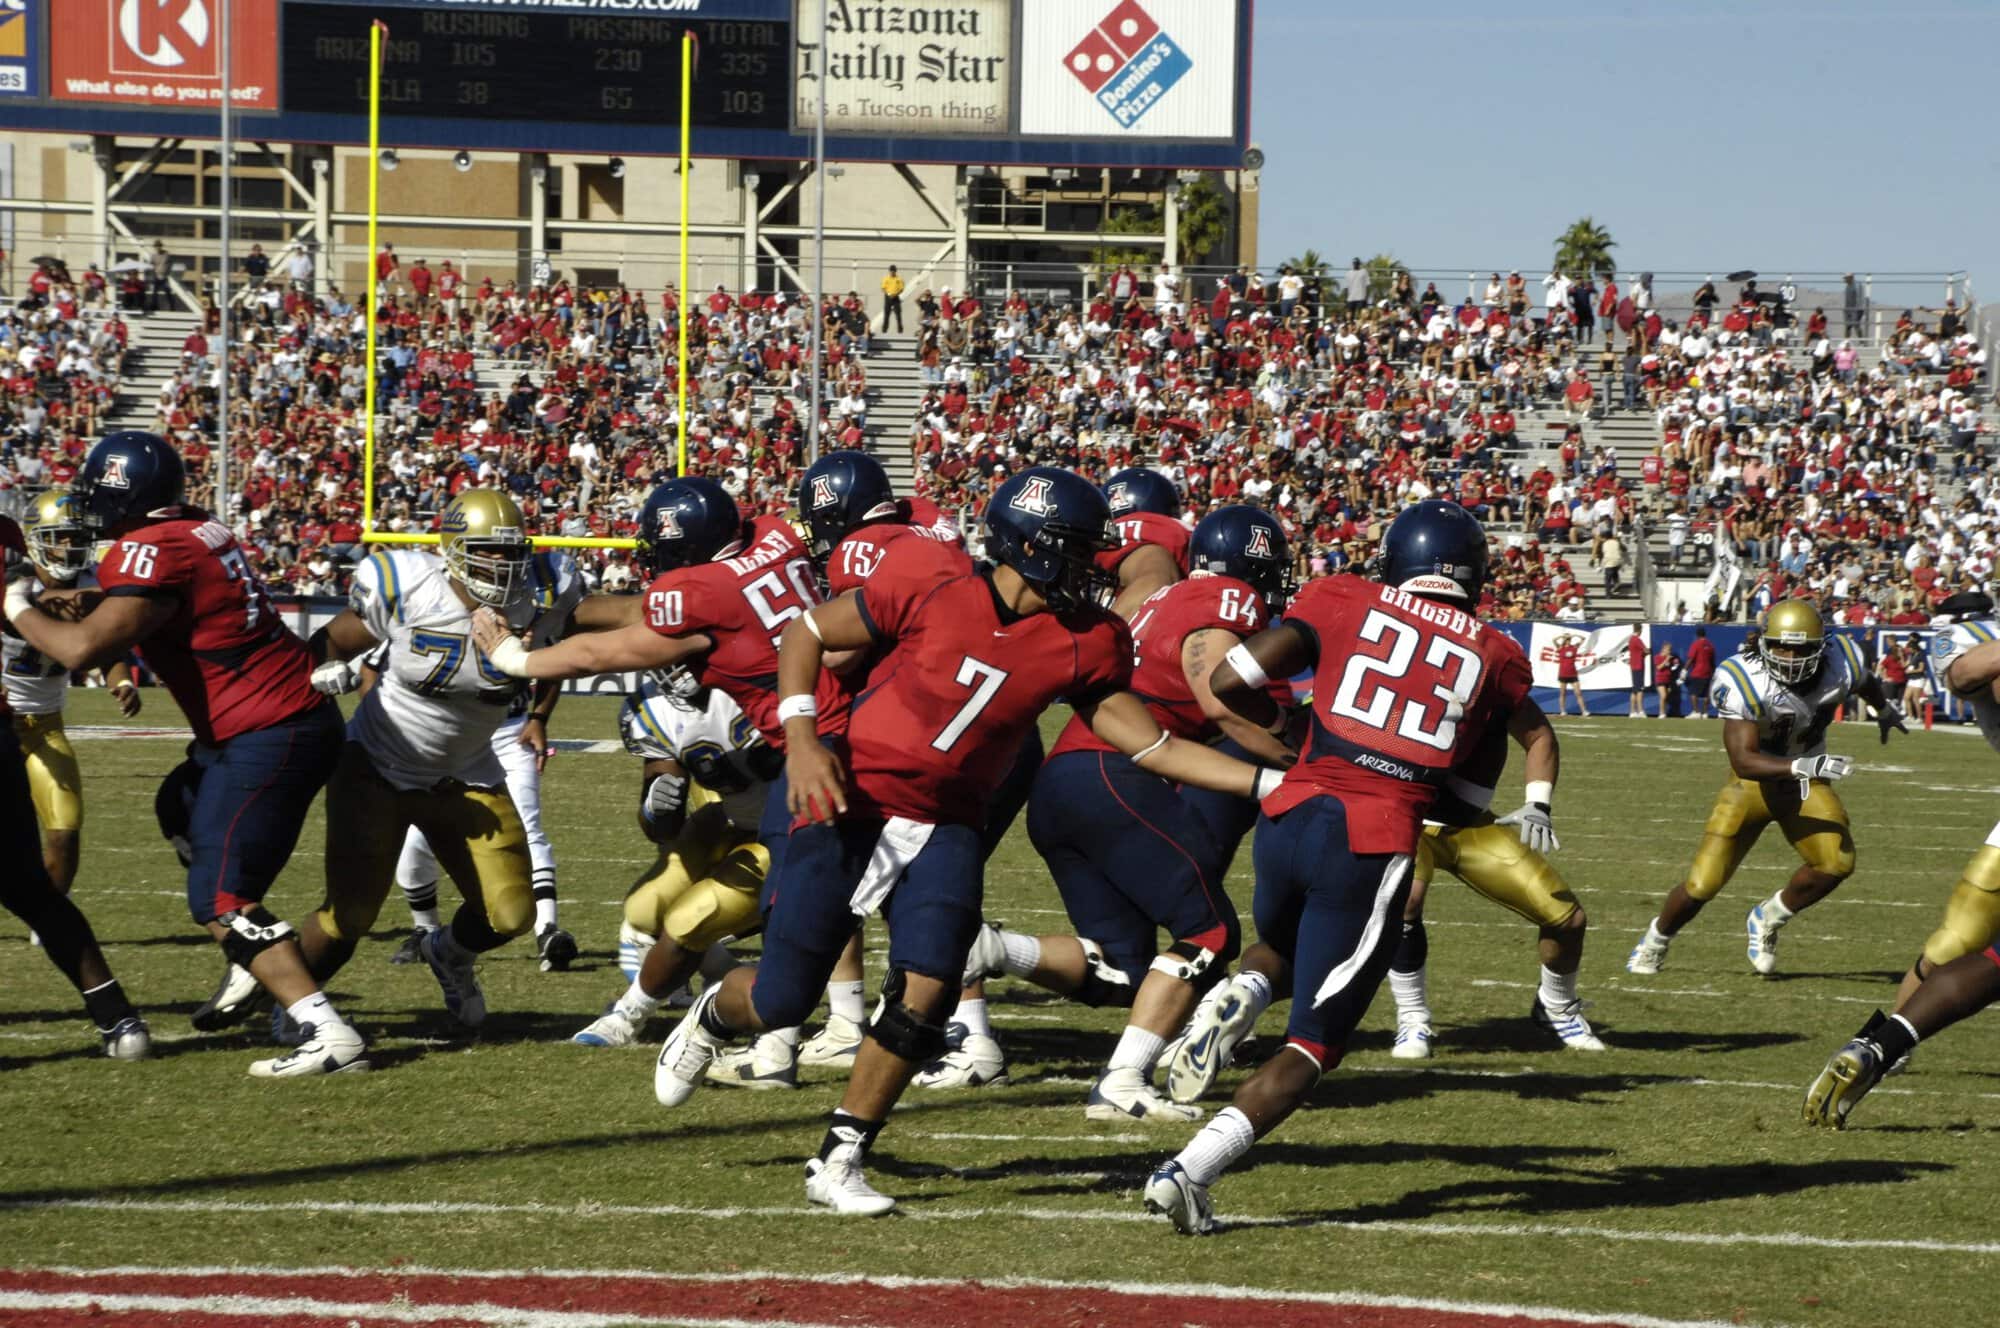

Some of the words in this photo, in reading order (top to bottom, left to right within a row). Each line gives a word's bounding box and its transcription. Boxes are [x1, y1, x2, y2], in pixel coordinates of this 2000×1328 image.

[422, 12, 529, 39] RUSHING
[569, 18, 671, 43] PASSING
[705, 23, 780, 47] TOTAL
[825, 0, 981, 37] Arizona
[316, 37, 421, 63] ARIZNA
[452, 42, 497, 67] 105
[594, 48, 642, 72] 230
[720, 53, 767, 76] 335
[916, 43, 1005, 83] Star
[66, 79, 111, 94] What
[114, 82, 149, 96] else
[152, 83, 174, 98] do
[177, 87, 208, 100] you
[210, 87, 264, 101] ned?
[1100, 42, 1171, 110] Domino's
[601, 86, 634, 110] 65
[721, 89, 764, 114] 103
[837, 102, 850, 116] a
[857, 98, 933, 118] Tucson
[942, 101, 998, 124] thing
[1115, 82, 1163, 125] Pizza
[1009, 475, 1054, 518] A
[1245, 525, 1273, 560] A
[1693, 532, 1713, 545] 30
[119, 541, 159, 579] 76
[841, 540, 874, 578] 75
[1411, 579, 1455, 591] ARIZONA
[649, 590, 683, 627] 50
[1219, 588, 1258, 627] 64
[1380, 585, 1483, 641] GRIGSBY
[1330, 607, 1483, 751] 23
[930, 655, 1010, 754] 7
[1354, 753, 1415, 782] ARIZONA
